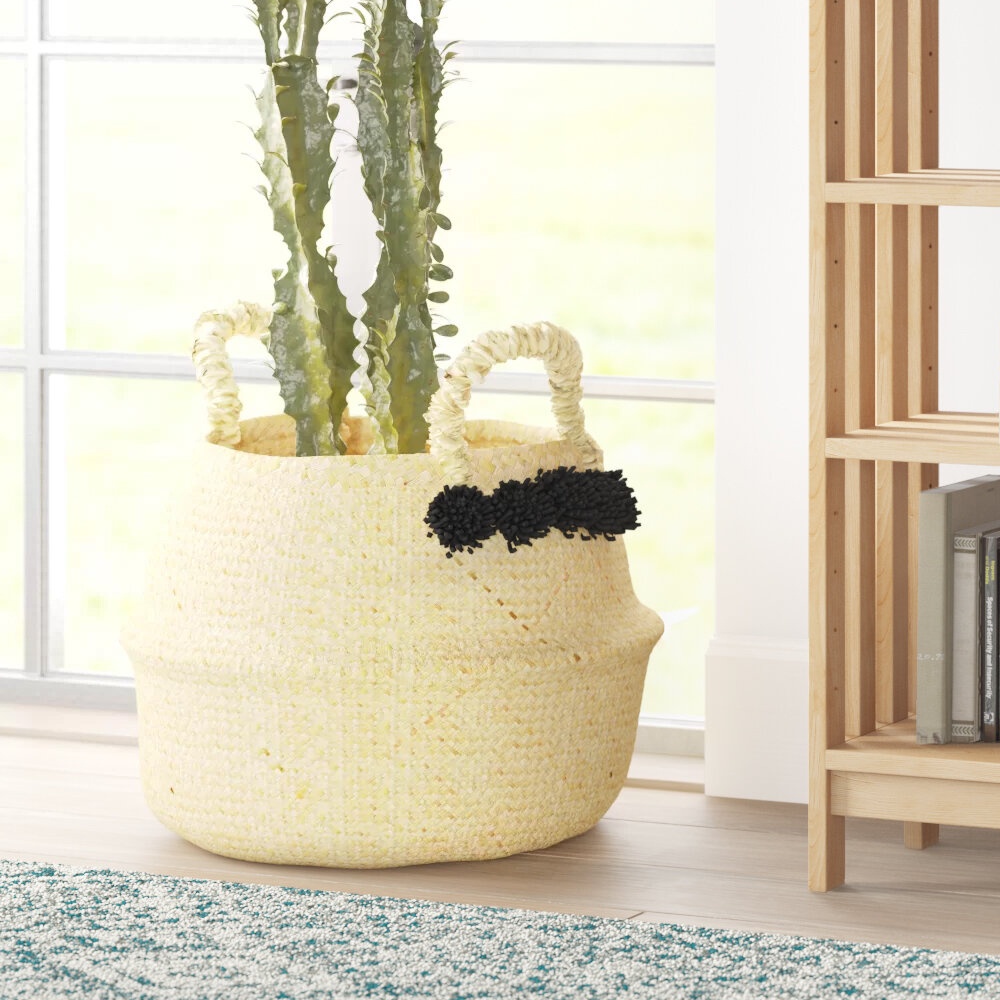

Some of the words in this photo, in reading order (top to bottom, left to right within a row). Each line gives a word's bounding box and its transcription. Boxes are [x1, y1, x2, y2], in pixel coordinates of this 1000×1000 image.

[986, 596, 994, 619] Spaces
[985, 627, 993, 654] Security
[985, 667, 993, 699] Insecurity
